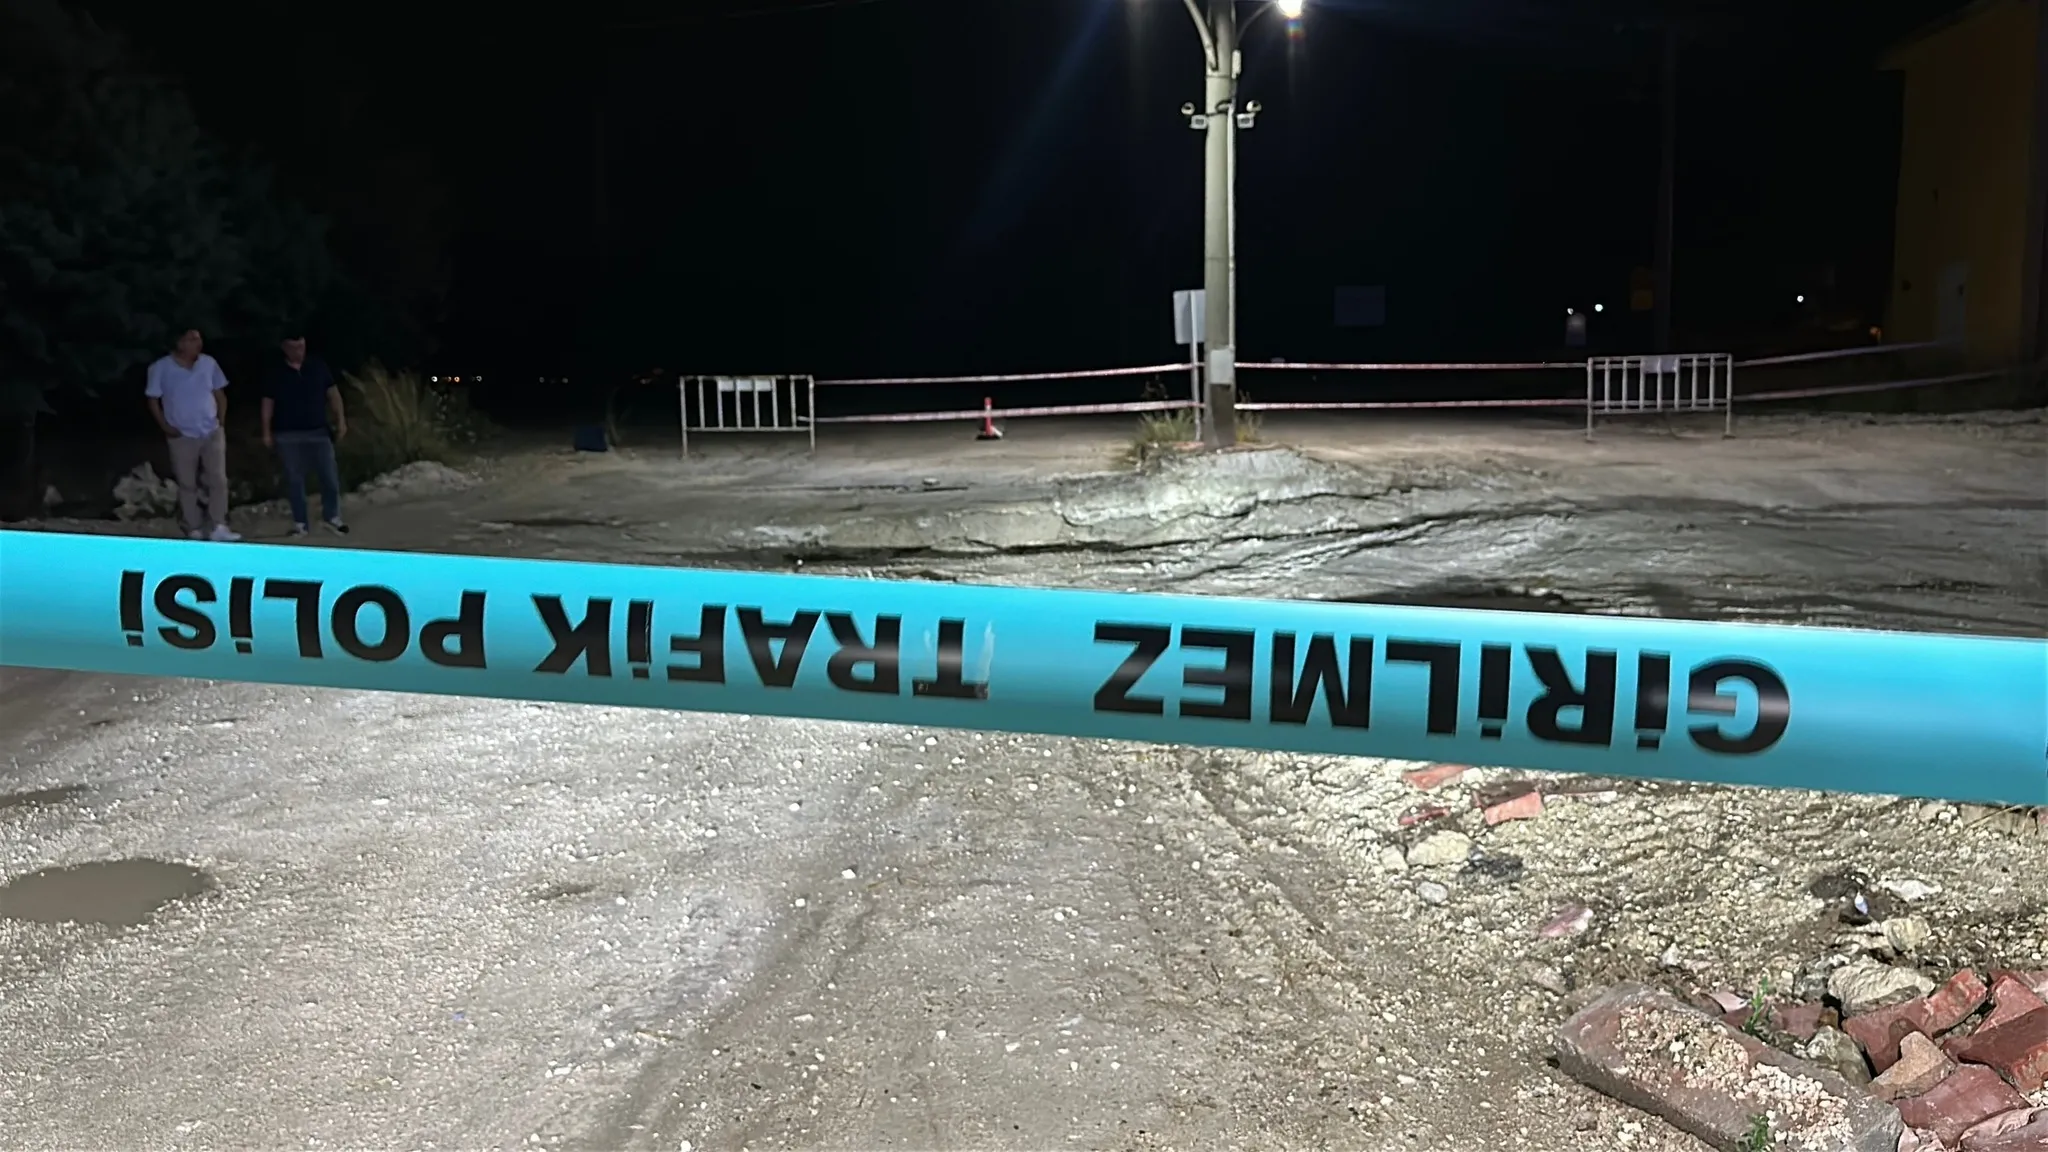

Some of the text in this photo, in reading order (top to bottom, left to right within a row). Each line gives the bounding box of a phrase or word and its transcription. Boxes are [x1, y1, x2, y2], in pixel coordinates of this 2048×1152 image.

[119, 569, 1790, 756] GİRİLMEZ TRAFİK POLİSİ
